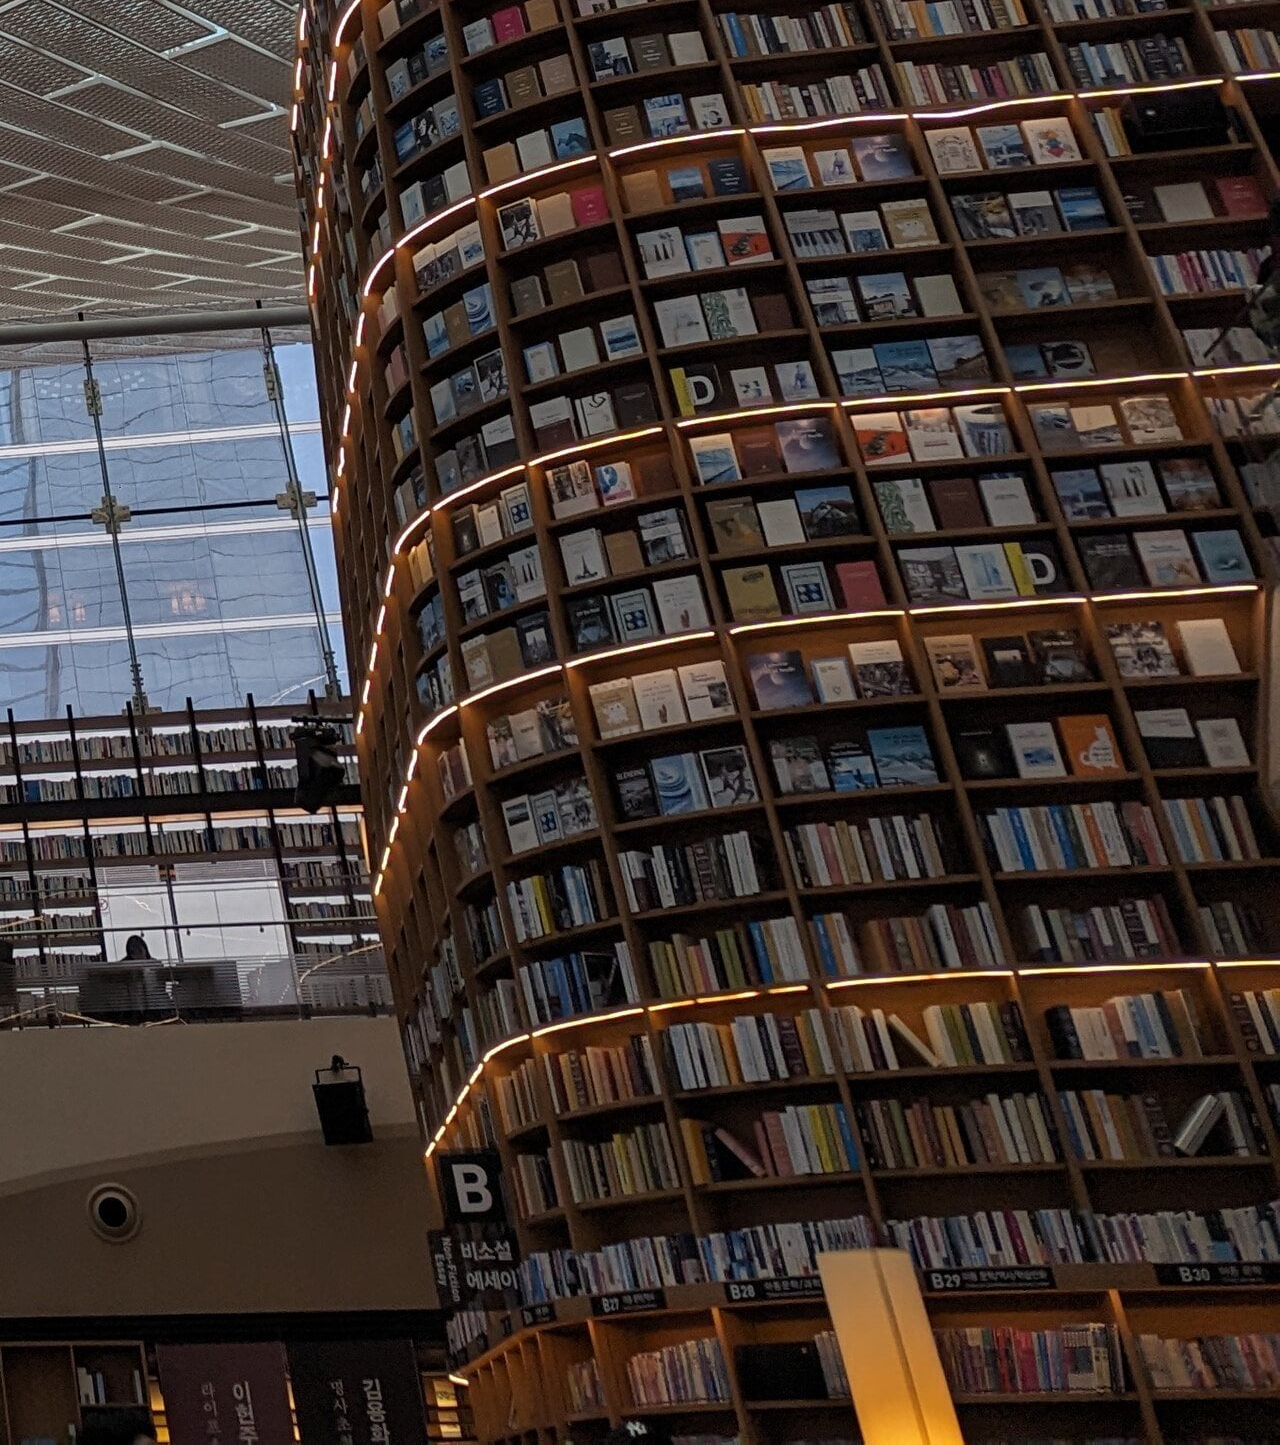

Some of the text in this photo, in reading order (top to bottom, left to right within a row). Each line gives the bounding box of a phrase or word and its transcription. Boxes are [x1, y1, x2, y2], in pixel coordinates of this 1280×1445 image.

[452, 1163, 493, 1214] B
[460, 1239, 514, 1262] 비소설
[435, 1253, 448, 1287] Essay
[441, 1236, 461, 1303] Non-Fiction
[466, 1268, 519, 1291] 에세이
[931, 1272, 962, 1290] B29
[1178, 1266, 1210, 1283] B30
[730, 1283, 756, 1300] B28
